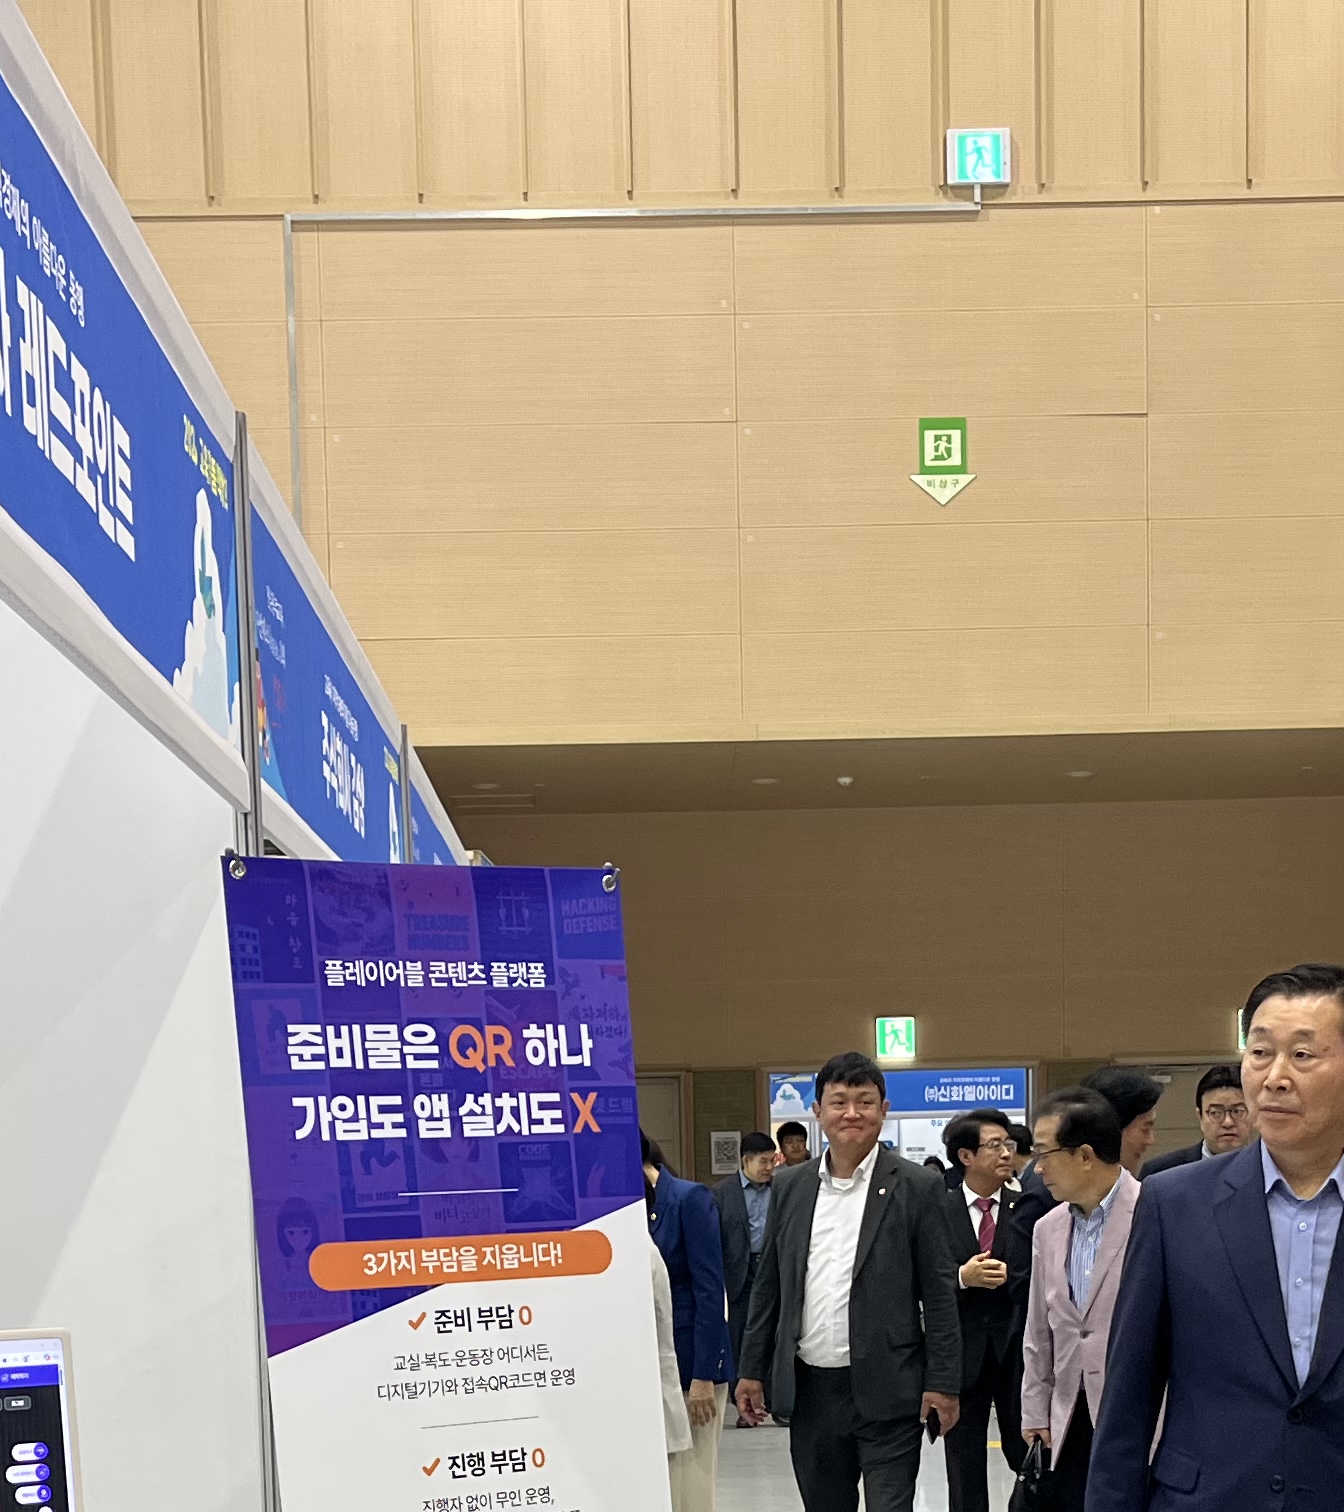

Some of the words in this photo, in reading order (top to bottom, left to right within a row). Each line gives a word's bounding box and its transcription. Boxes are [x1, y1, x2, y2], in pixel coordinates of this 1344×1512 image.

[32, 216, 66, 302] 아름다운
[16, 273, 135, 560] 레드포인트
[926, 478, 960, 489] 비상구
[324, 960, 424, 988] 플레이어블
[429, 960, 486, 988] 콘텐츠
[490, 962, 547, 988] 플랫폼
[286, 1024, 439, 1071] 준비물은
[449, 1024, 516, 1073] QR
[522, 1024, 593, 1067] 하나
[292, 1094, 406, 1141] 가입도
[413, 1093, 452, 1139] 앱
[458, 1092, 565, 1138] 설치도
[570, 1091, 601, 1133] X
[363, 1248, 416, 1276] 3가지
[420, 1246, 479, 1275] 부담을
[481, 1241, 563, 1270] 지웁니다!
[433, 1306, 473, 1333] 준비
[476, 1304, 514, 1331] 부담
[518, 1305, 532, 1326] 0
[497, 1343, 554, 1364] 어디서든,
[377, 1380, 459, 1402] 디지털기기와
[461, 1371, 547, 1394] 접속QR코드면
[550, 1367, 576, 1386] 운영
[447, 1451, 485, 1479] 진행
[490, 1447, 528, 1475] 부담
[531, 1447, 545, 1468] 0
[465, 1491, 493, 1512] 없이
[495, 1488, 522, 1509] 무인
[524, 1485, 555, 1506] 운영,
